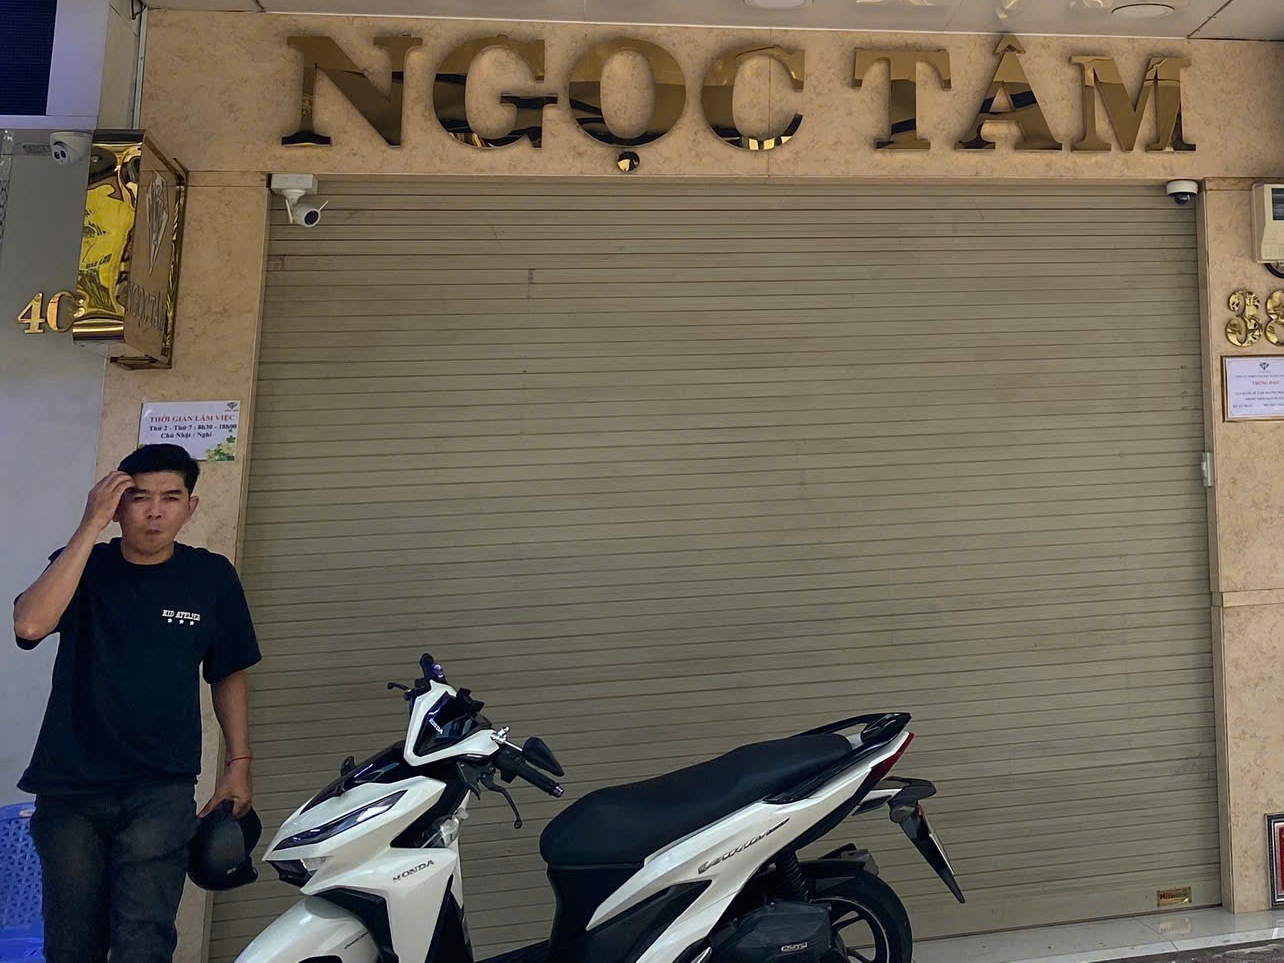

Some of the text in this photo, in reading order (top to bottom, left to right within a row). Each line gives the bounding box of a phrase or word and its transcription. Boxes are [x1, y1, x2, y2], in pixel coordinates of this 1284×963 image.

[281, 34, 1197, 172] NGỌC TÂM
[428, 717, 444, 735] HONDA
[392, 858, 435, 882] HONDA
